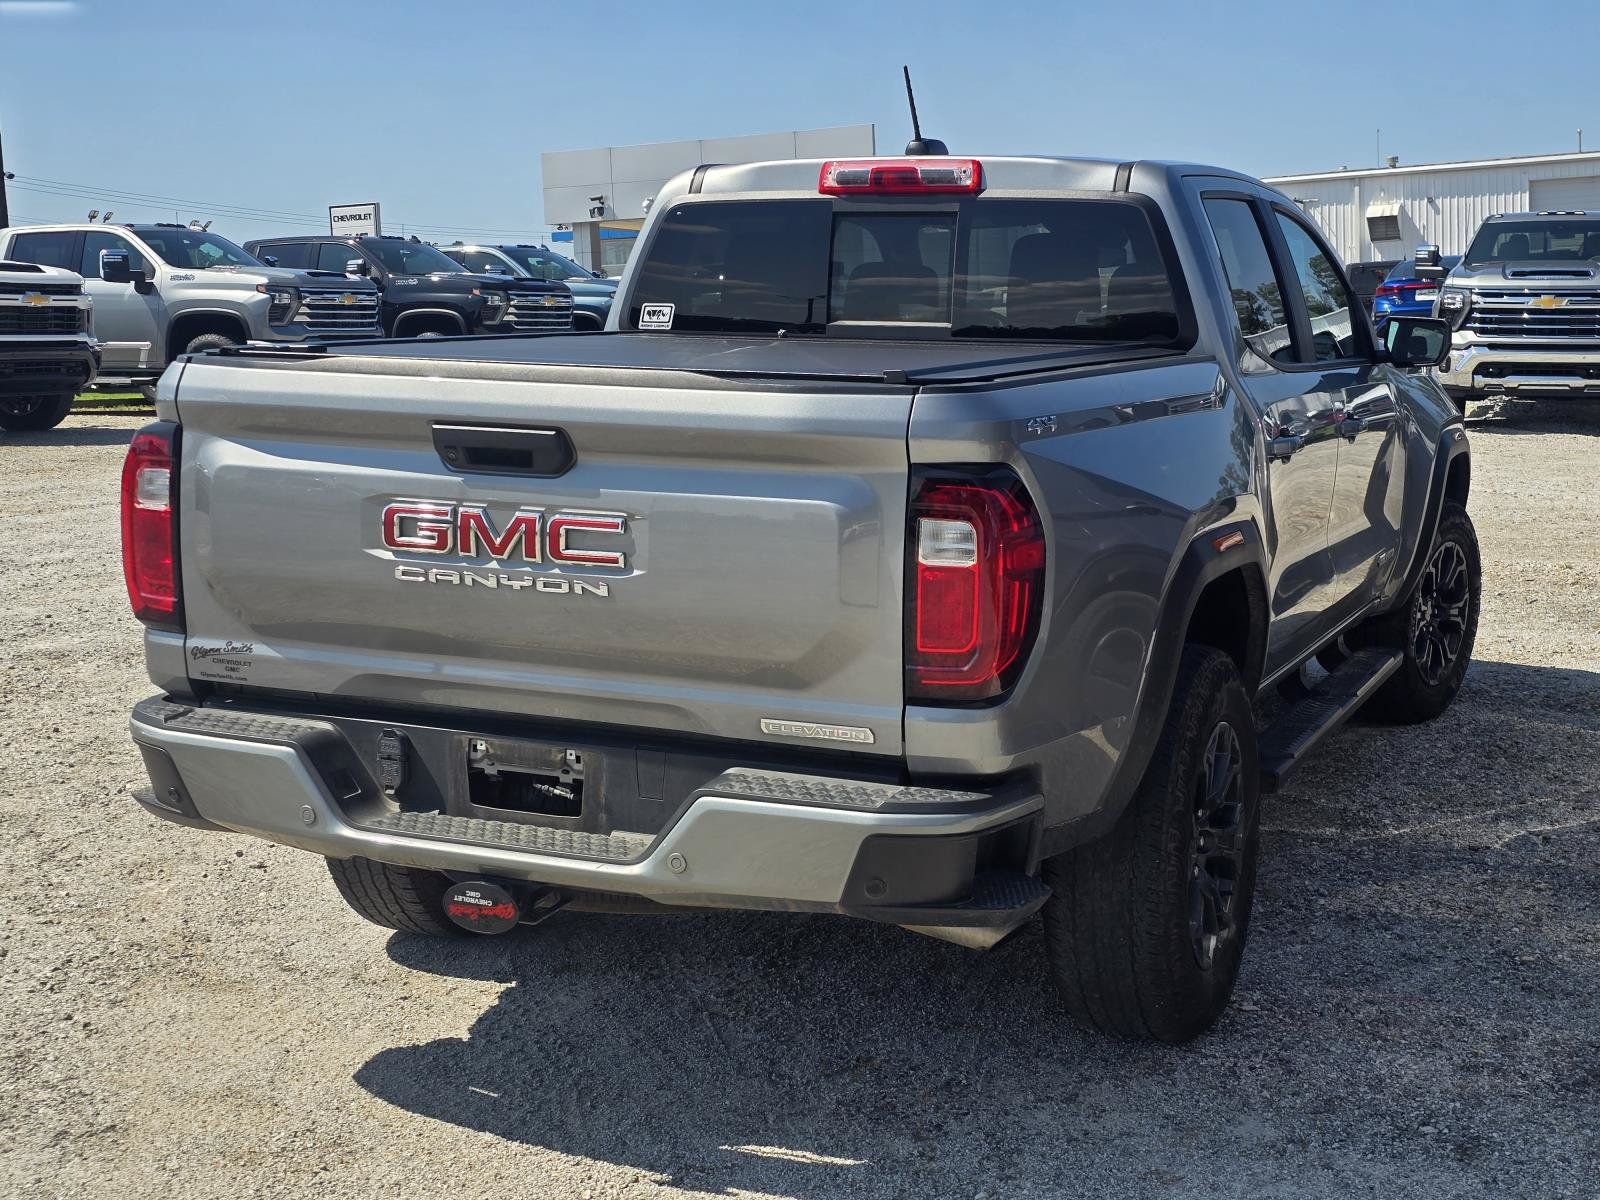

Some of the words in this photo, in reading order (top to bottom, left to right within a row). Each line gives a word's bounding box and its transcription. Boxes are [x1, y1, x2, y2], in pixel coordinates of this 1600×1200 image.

[333, 213, 372, 223] CHEVROLET
[382, 502, 627, 569] GMC
[394, 565, 609, 597] CANYON
[223, 640, 254, 654] Smith
[212, 657, 252, 667] CHEVROLET
[224, 665, 241, 673] GMC
[769, 723, 866, 740] ELEVATION
[453, 894, 493, 906] CHEVROLET
[465, 890, 481, 898] GMC
